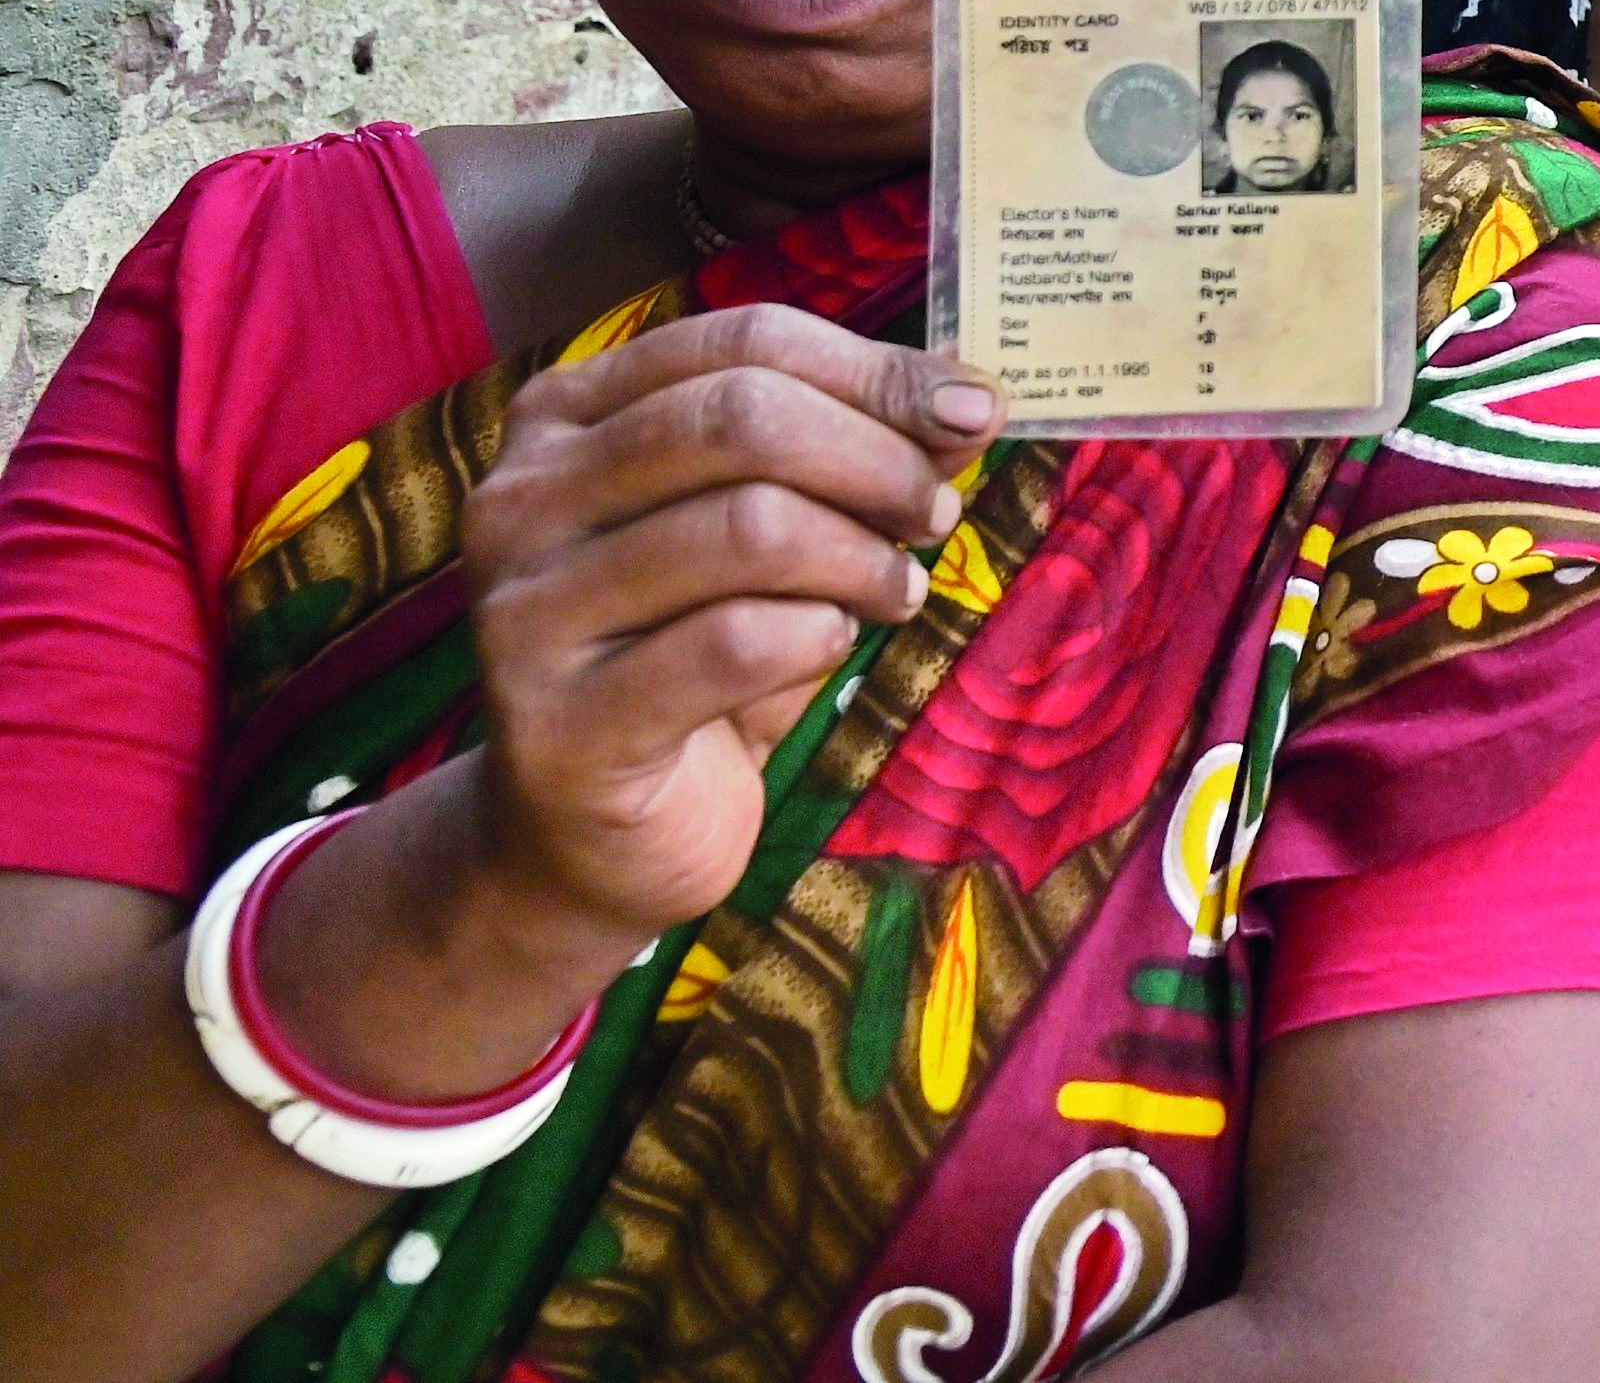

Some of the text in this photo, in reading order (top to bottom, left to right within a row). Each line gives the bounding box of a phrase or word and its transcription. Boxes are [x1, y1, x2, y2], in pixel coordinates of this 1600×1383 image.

[1189, 1, 1217, 15] WB
[1233, 0, 1252, 14] 12
[1267, 0, 1297, 13] 078
[1000, 14, 1119, 29] IDENTITY CARD
[1001, 207, 1070, 221] Elector's
[1074, 206, 1120, 219] Name
[1001, 250, 1118, 265] Father/Mother/
[1001, 266, 1236, 285] Husband's Name Bipul
[1001, 317, 1030, 330] Sex
[1000, 367, 1029, 383] Age
[1035, 368, 1051, 378] as
[1058, 367, 1077, 378] on
